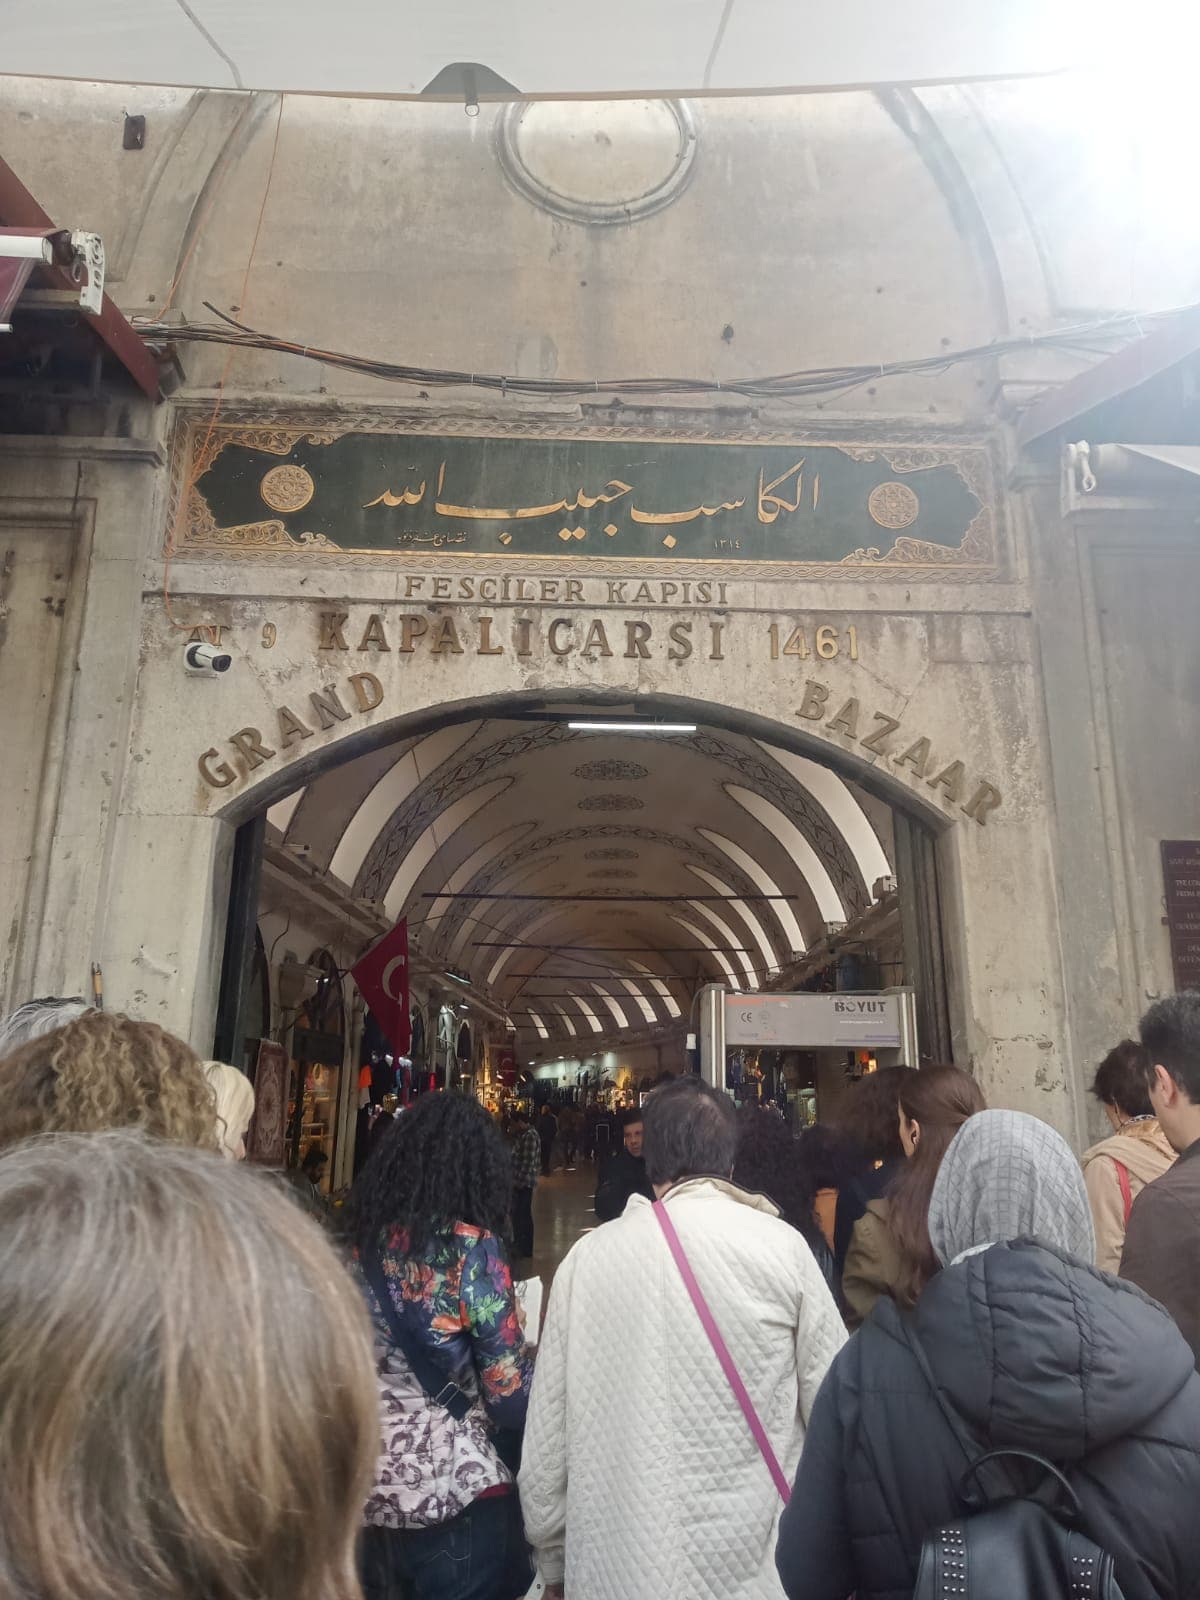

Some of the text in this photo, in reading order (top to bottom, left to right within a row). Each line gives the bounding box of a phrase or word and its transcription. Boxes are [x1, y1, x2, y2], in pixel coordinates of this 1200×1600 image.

[606, 581, 729, 604] KAPISI
[261, 622, 277, 649] 9
[766, 623, 860, 661] 1461
[197, 672, 1002, 827] GRAND BAZAAR
[834, 1001, 887, 1013] BOYUT
